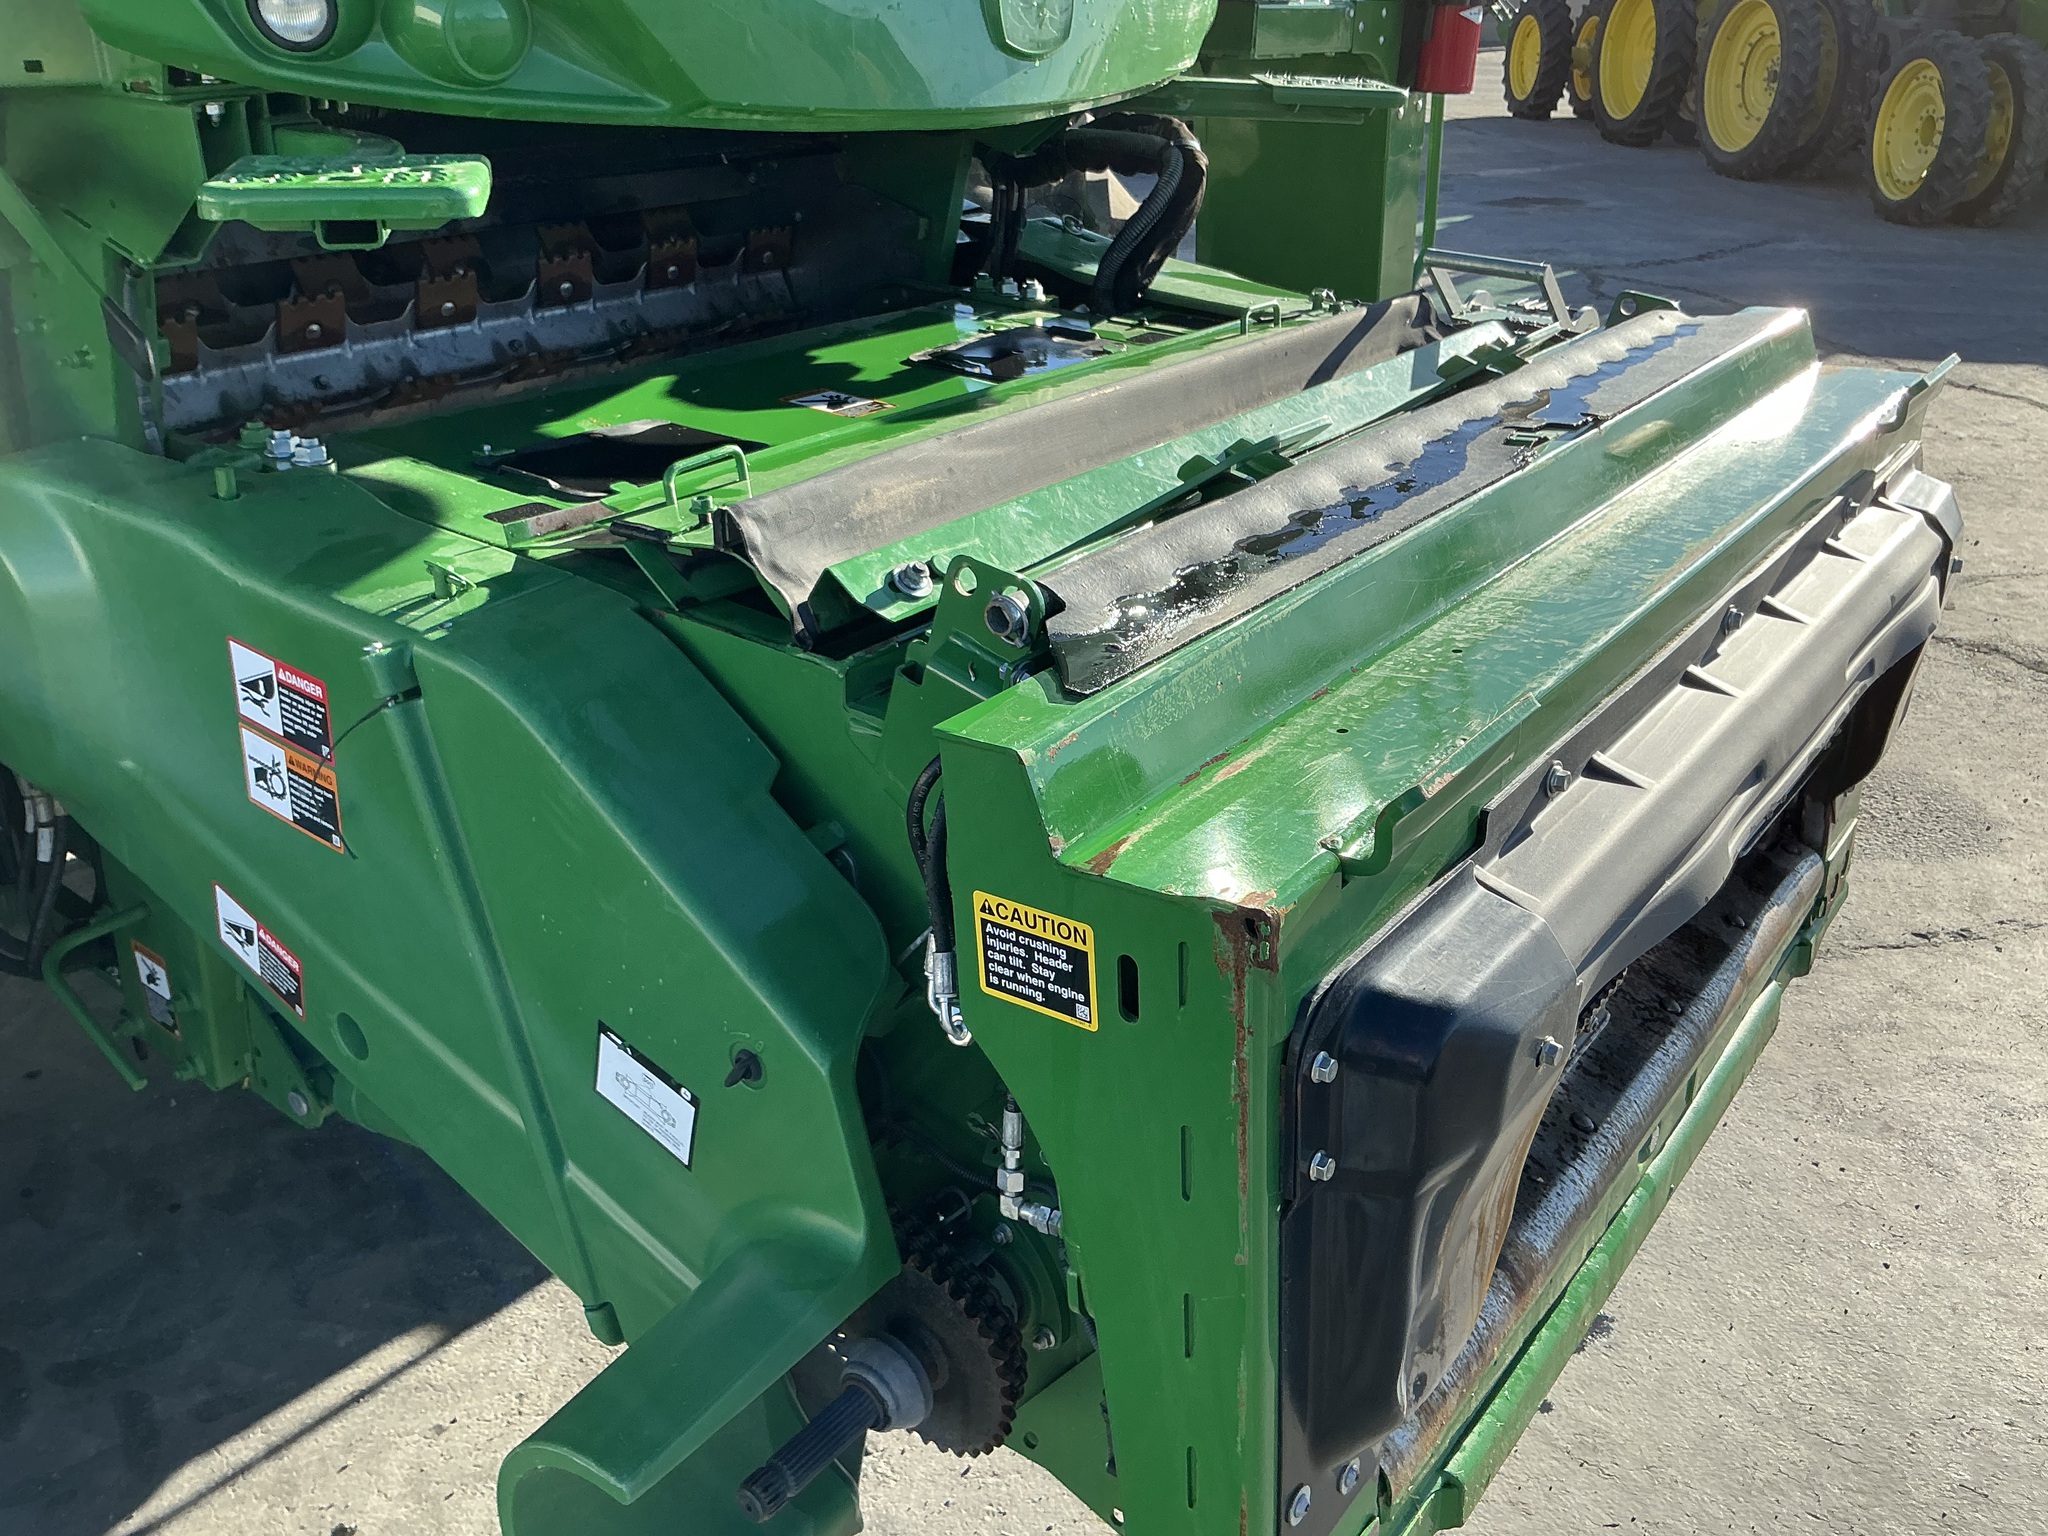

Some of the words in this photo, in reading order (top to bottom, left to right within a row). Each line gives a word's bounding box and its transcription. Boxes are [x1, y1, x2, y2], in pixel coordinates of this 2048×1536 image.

[284, 670, 323, 699] DANGER
[985, 922, 1016, 942] Avoid
[1018, 935, 1067, 960] crushing
[995, 902, 1087, 946] CAUTION
[986, 935, 1029, 958] injuries.
[1034, 951, 1074, 973] Header
[987, 950, 1007, 963] can
[1009, 955, 1026, 970] tilt.
[1031, 963, 1056, 981] Stay
[988, 962, 1014, 978] clear
[1016, 971, 1046, 989] when
[1047, 981, 1085, 1003] engine
[989, 972, 999, 985] is
[1001, 978, 1046, 1002] running.
